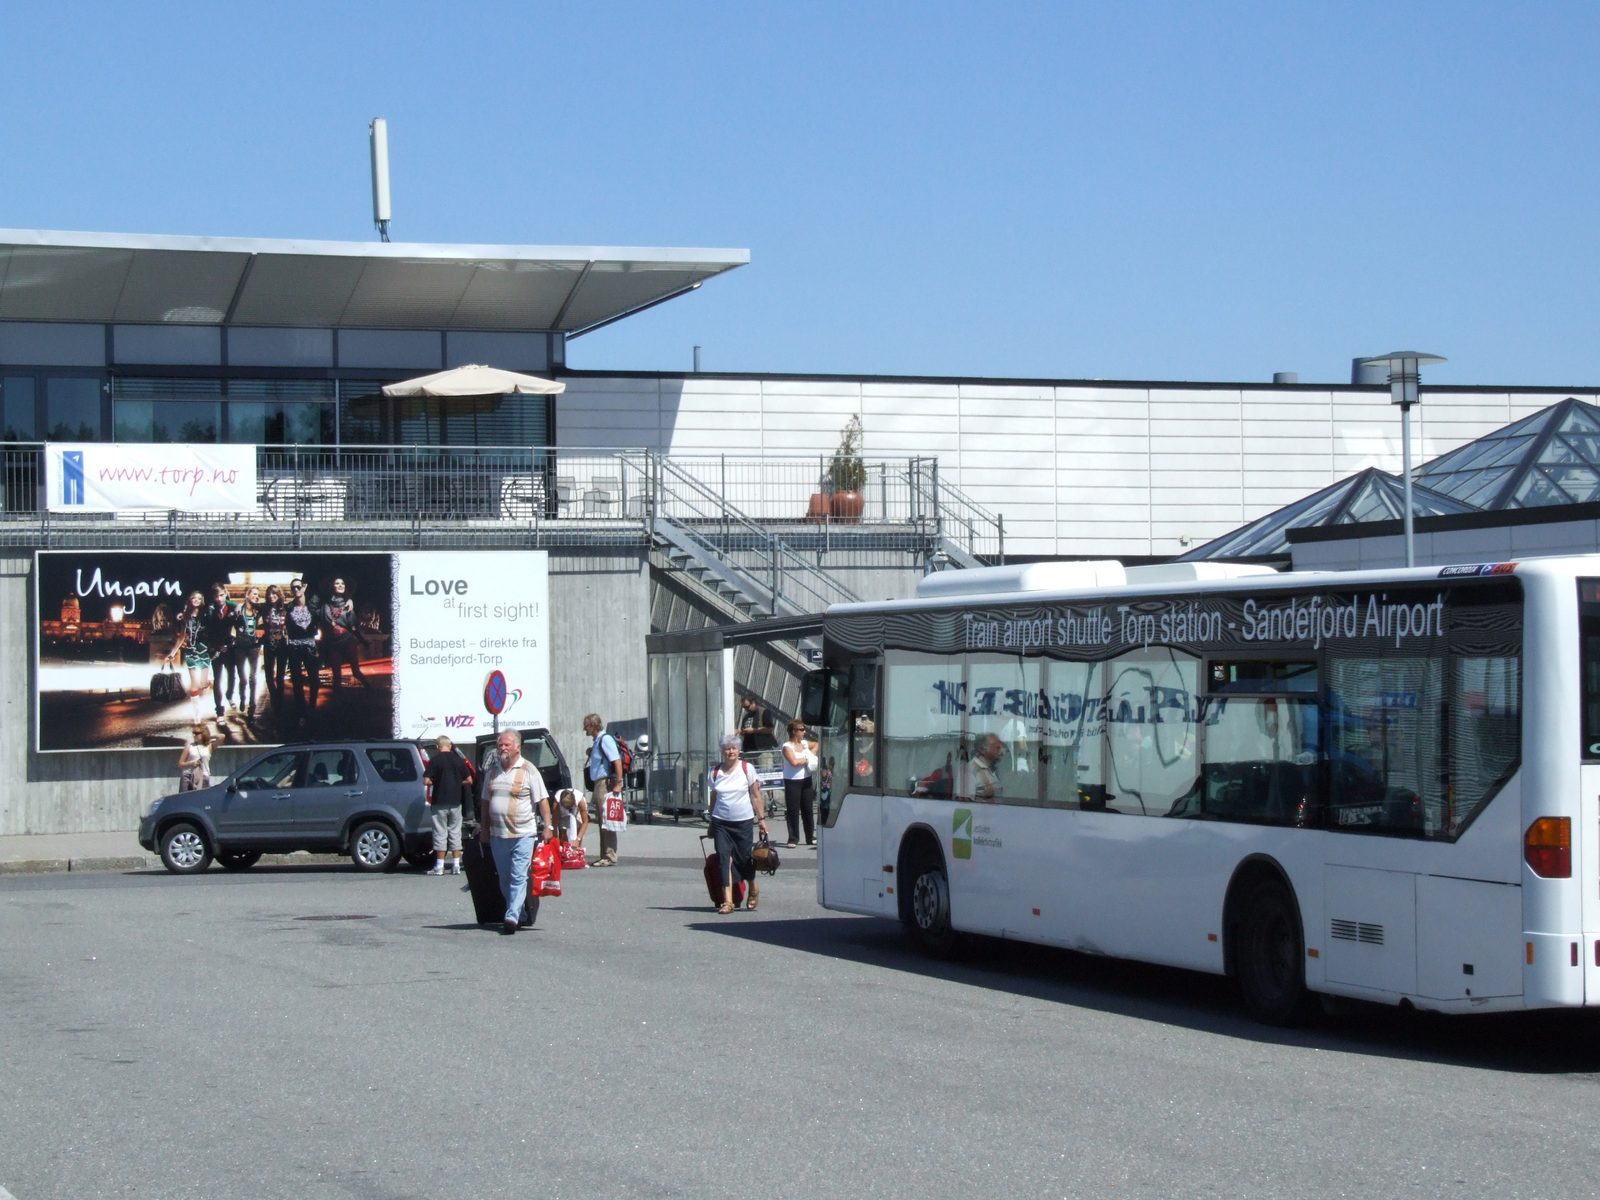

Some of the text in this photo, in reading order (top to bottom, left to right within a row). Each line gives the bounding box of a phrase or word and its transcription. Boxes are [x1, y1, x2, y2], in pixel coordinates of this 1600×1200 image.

[99, 465, 240, 497] www.torp.no
[76, 567, 182, 615] Ungarn
[410, 575, 468, 595] Love
[443, 596, 456, 609] at
[458, 602, 540, 622] first sight!
[963, 613, 999, 648] Train
[1004, 611, 1053, 655] airport
[1057, 607, 1112, 646] shuttle
[1117, 606, 1155, 653] Torp
[1160, 602, 1221, 643] station
[1242, 594, 1358, 650] Sandefjord
[1363, 593, 1444, 648] Airport
[410, 638, 466, 651] Budapest
[479, 637, 519, 649] direkte
[522, 636, 537, 648] fra
[410, 653, 503, 667] Sandefjord-Torp
[483, 719, 541, 729] ungnturisme.com
